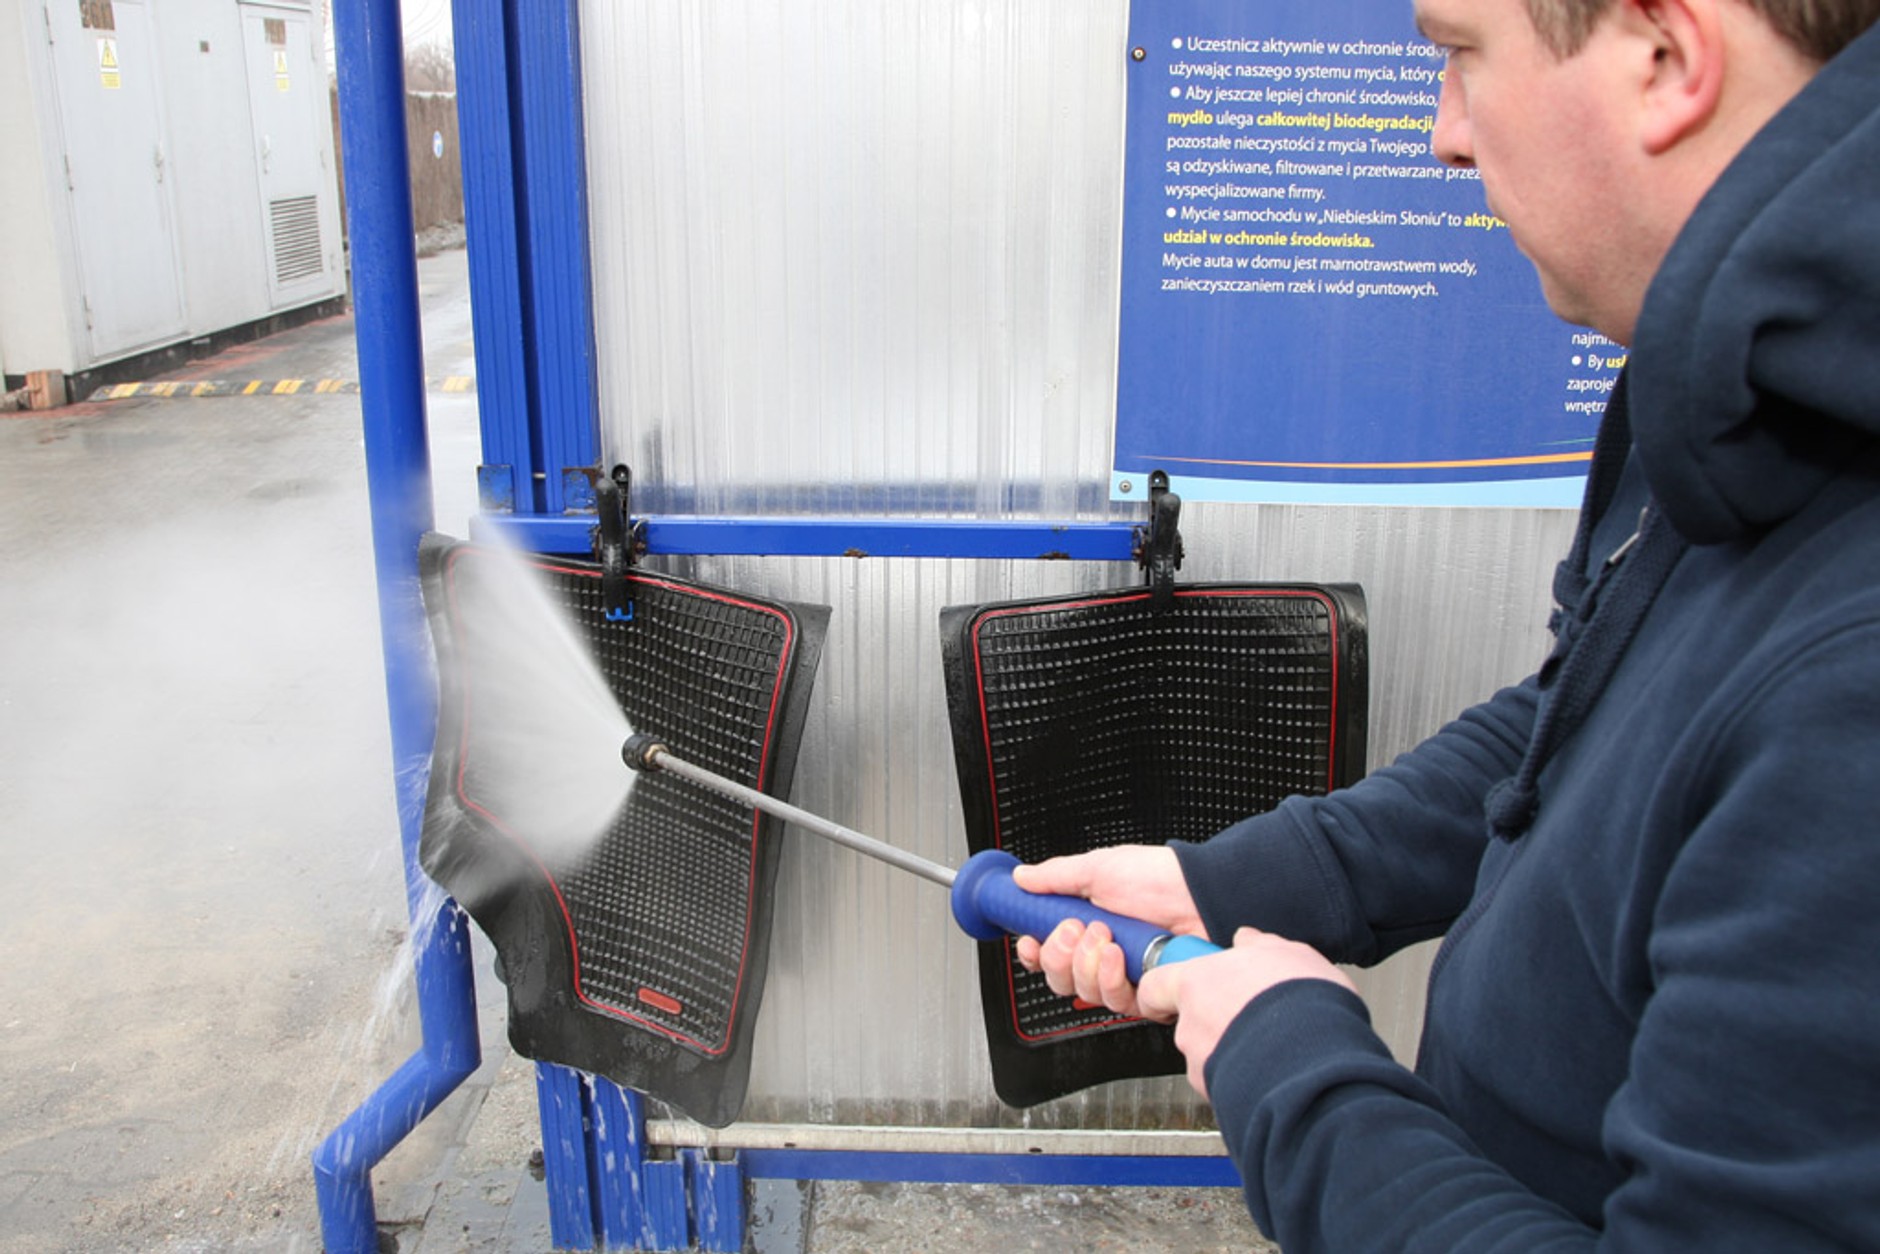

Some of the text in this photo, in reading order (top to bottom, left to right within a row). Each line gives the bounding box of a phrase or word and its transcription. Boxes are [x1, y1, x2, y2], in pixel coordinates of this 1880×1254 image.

[1188, 36, 1259, 52] Uczestnicz
[1262, 38, 1325, 56] aktywnie
[1327, 43, 1340, 54] w
[1343, 40, 1403, 56] ochronie
[1169, 61, 1232, 79] używając
[1235, 65, 1292, 81] naszego
[1295, 65, 1352, 81] systemu
[1354, 66, 1397, 83] mycia,
[1400, 66, 1436, 84] który
[1186, 85, 1439, 108] Aby jeszcze lepiej chronić środowisko,
[1168, 110, 1213, 127] mydło
[1216, 111, 1253, 129] ulega
[1256, 112, 1331, 130] całkowitej
[1167, 136, 1231, 151] pozostałe
[1234, 137, 1315, 153] nieczystości
[1317, 140, 1325, 151] z
[1328, 138, 1367, 155] mycia
[1370, 139, 1427, 157] Twojego
[1166, 161, 1180, 175] są
[1183, 160, 1273, 176] odzyskiwane,
[1276, 161, 1344, 176] filtrowane
[1353, 165, 1444, 179] przetwarzane
[1165, 183, 1325, 202] wyspecjalizowane firmy.
[1181, 206, 1220, 223] Mycie
[1223, 208, 1302, 222] samochodu
[1305, 212, 1317, 222] w
[1448, 214, 1462, 226] to
[1164, 230, 1375, 247] udział w ochronie środowiska.
[1163, 253, 1477, 276] Mycie auta w domu jest marnotrawstwem wody,
[1161, 277, 1284, 294] zanieczyszczaniem
[1288, 279, 1315, 293] rzek
[1325, 280, 1354, 294] wód
[1357, 282, 1438, 298] gruntowych.
[1588, 354, 1604, 371] By
